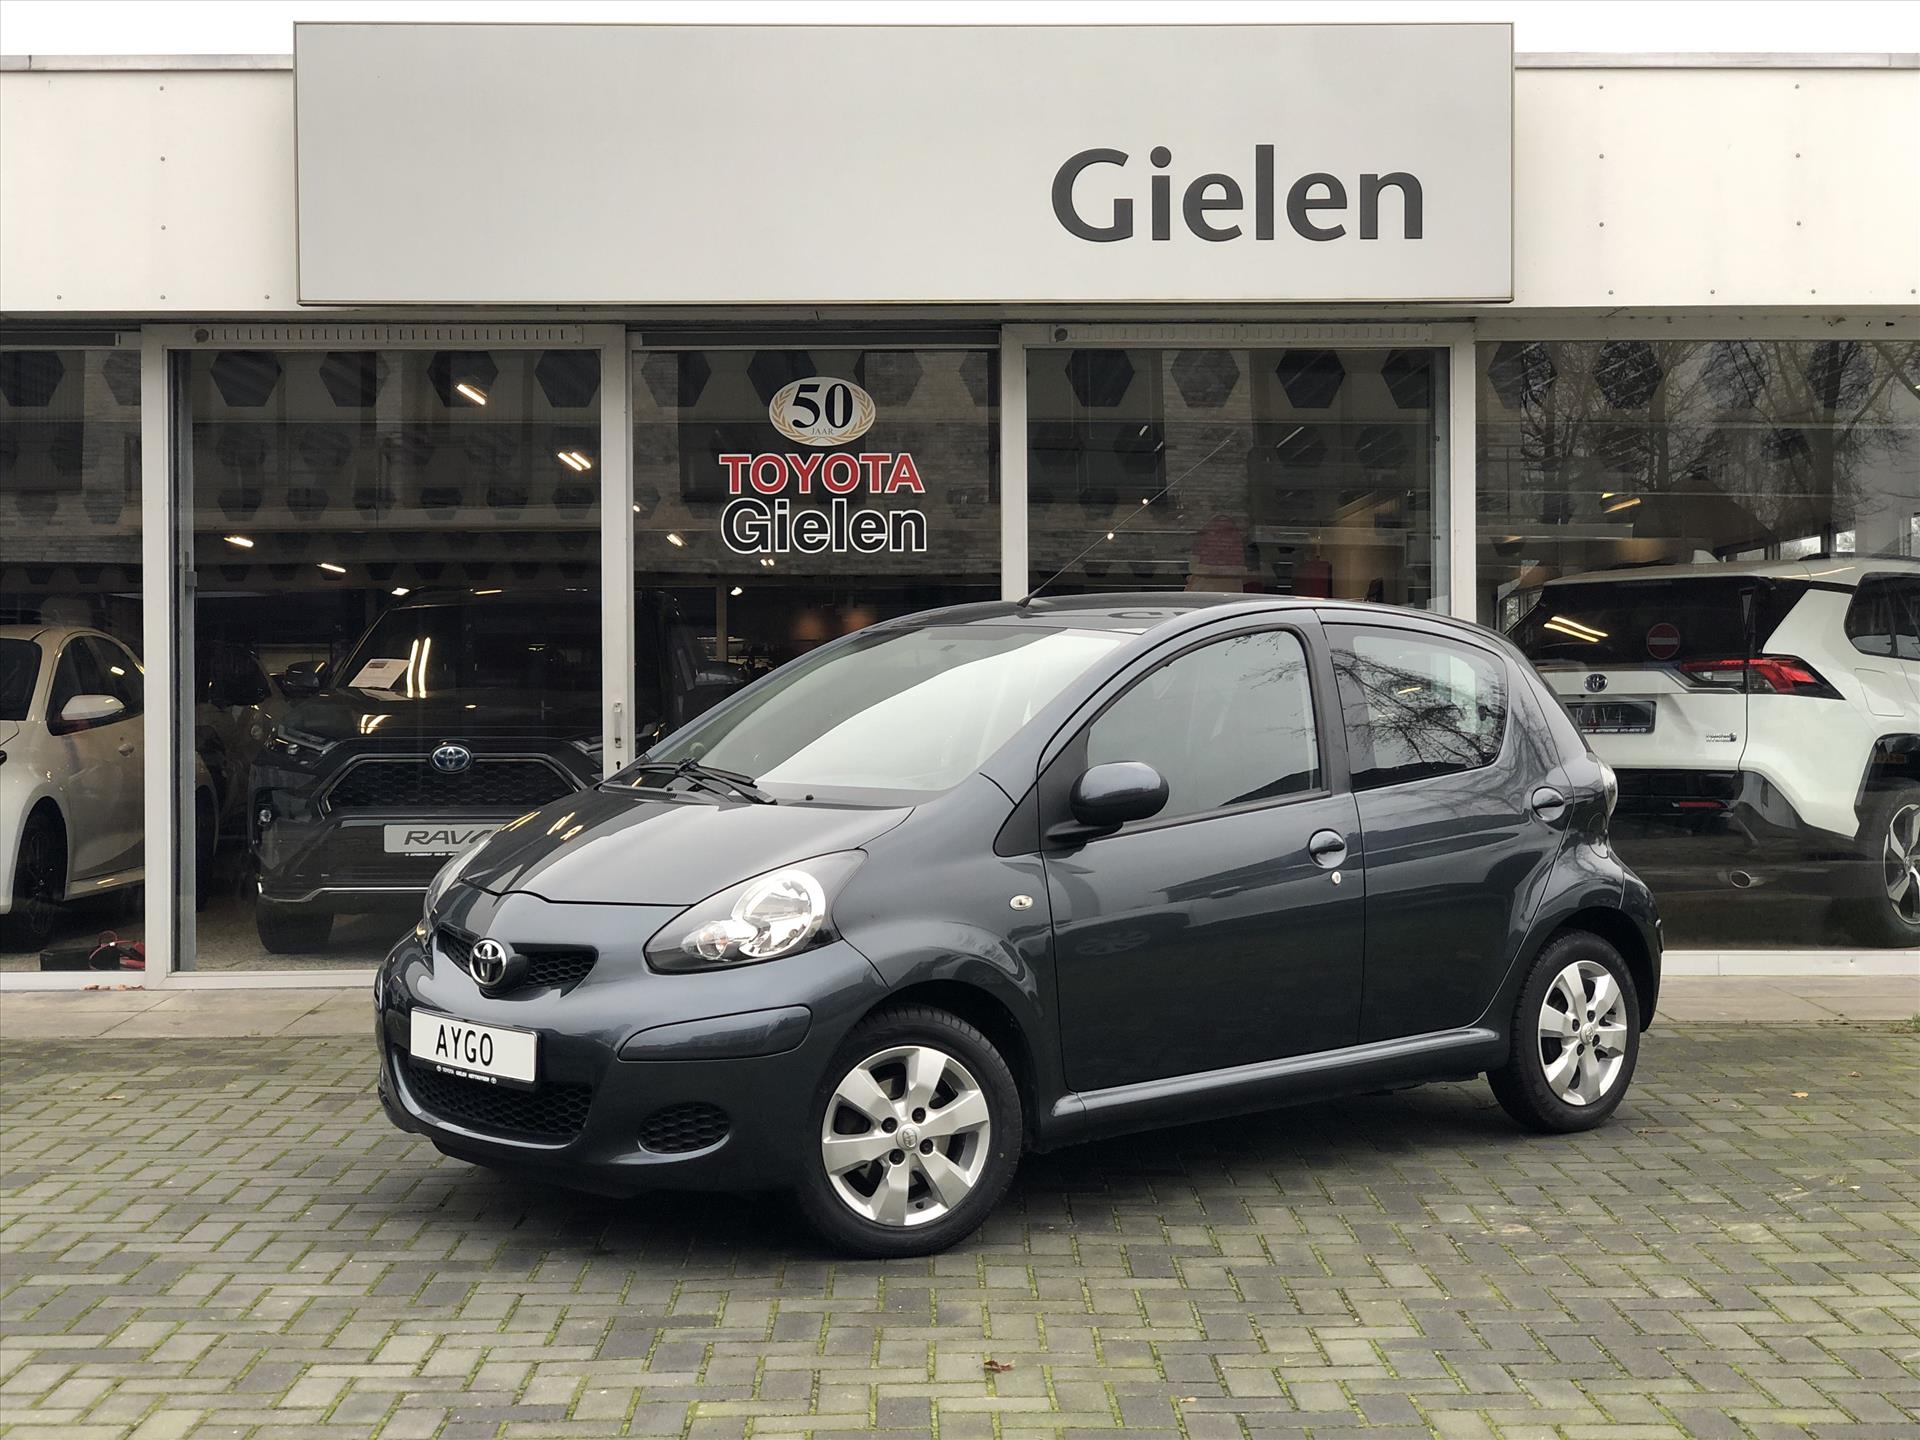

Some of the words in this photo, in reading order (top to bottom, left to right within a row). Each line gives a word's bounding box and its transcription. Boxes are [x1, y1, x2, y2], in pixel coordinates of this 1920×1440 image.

[1051, 144, 1423, 243] Gielen
[792, 383, 853, 429] 50
[810, 427, 834, 436] JAAR
[719, 453, 926, 495] TOYOTA
[720, 498, 927, 554] Gielen
[436, 1024, 493, 1067] AYGO
